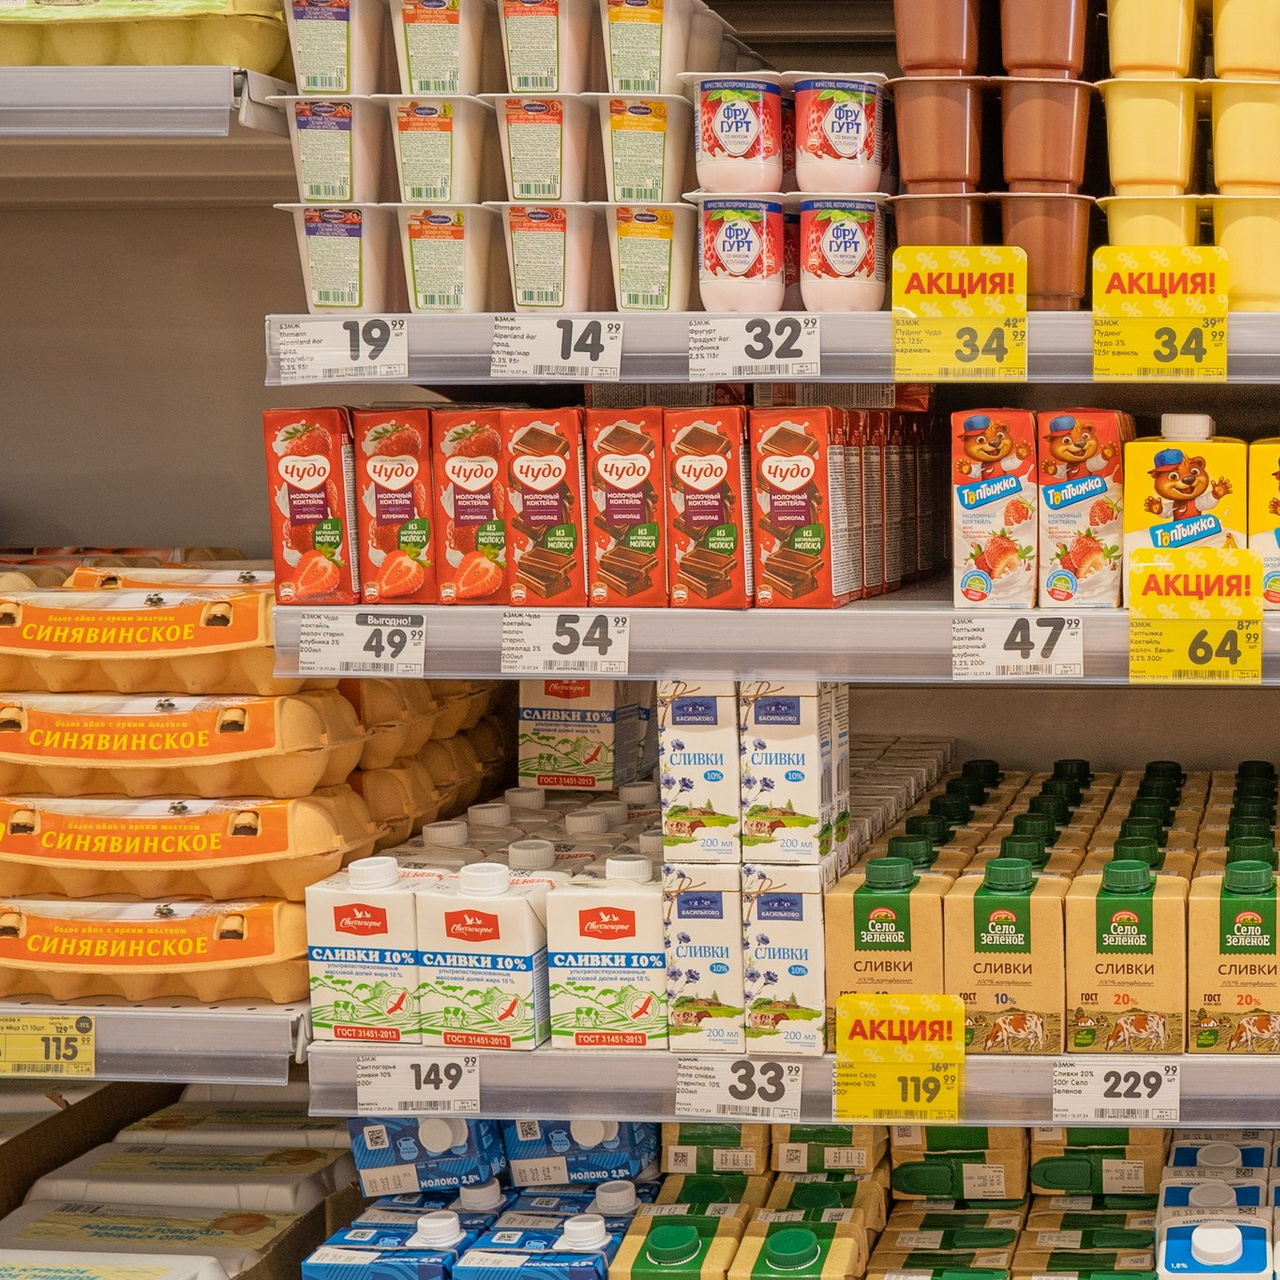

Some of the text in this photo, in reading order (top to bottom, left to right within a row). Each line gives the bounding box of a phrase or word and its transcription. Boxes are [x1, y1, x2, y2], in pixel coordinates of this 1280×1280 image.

[723, 103, 749, 120] ФРУ
[721, 118, 750, 134] ГУРТ
[342, 321, 390, 360] 19
[556, 321, 604, 360] 14
[745, 319, 802, 359] 32
[955, 326, 1008, 363] 34
[284, 459, 330, 482] Чудо
[1142, 574, 1250, 599] АКЦИЯ!
[22, 622, 195, 644] СИНЯВИНСКОЕ
[364, 630, 405, 658] 49
[552, 615, 611, 655] 54
[1004, 617, 1065, 660] 47
[1188, 630, 1241, 665] 64
[670, 751, 723, 768] СЛИВКИ
[42, 830, 222, 851] СИНЯВИНСКОЕ
[701, 838, 734, 848] 200 мл
[312, 947, 414, 964] СЛИВКИ 10%
[1095, 964, 1154, 975] СЛИВКИ
[1114, 993, 1138, 1006] 20%
[337, 1027, 397, 1039] ГОСТ 31451-2013
[41, 1037, 78, 1060] 115
[409, 1063, 462, 1091] 149
[729, 1060, 785, 1101] 33
[1103, 1071, 1162, 1099] 229
